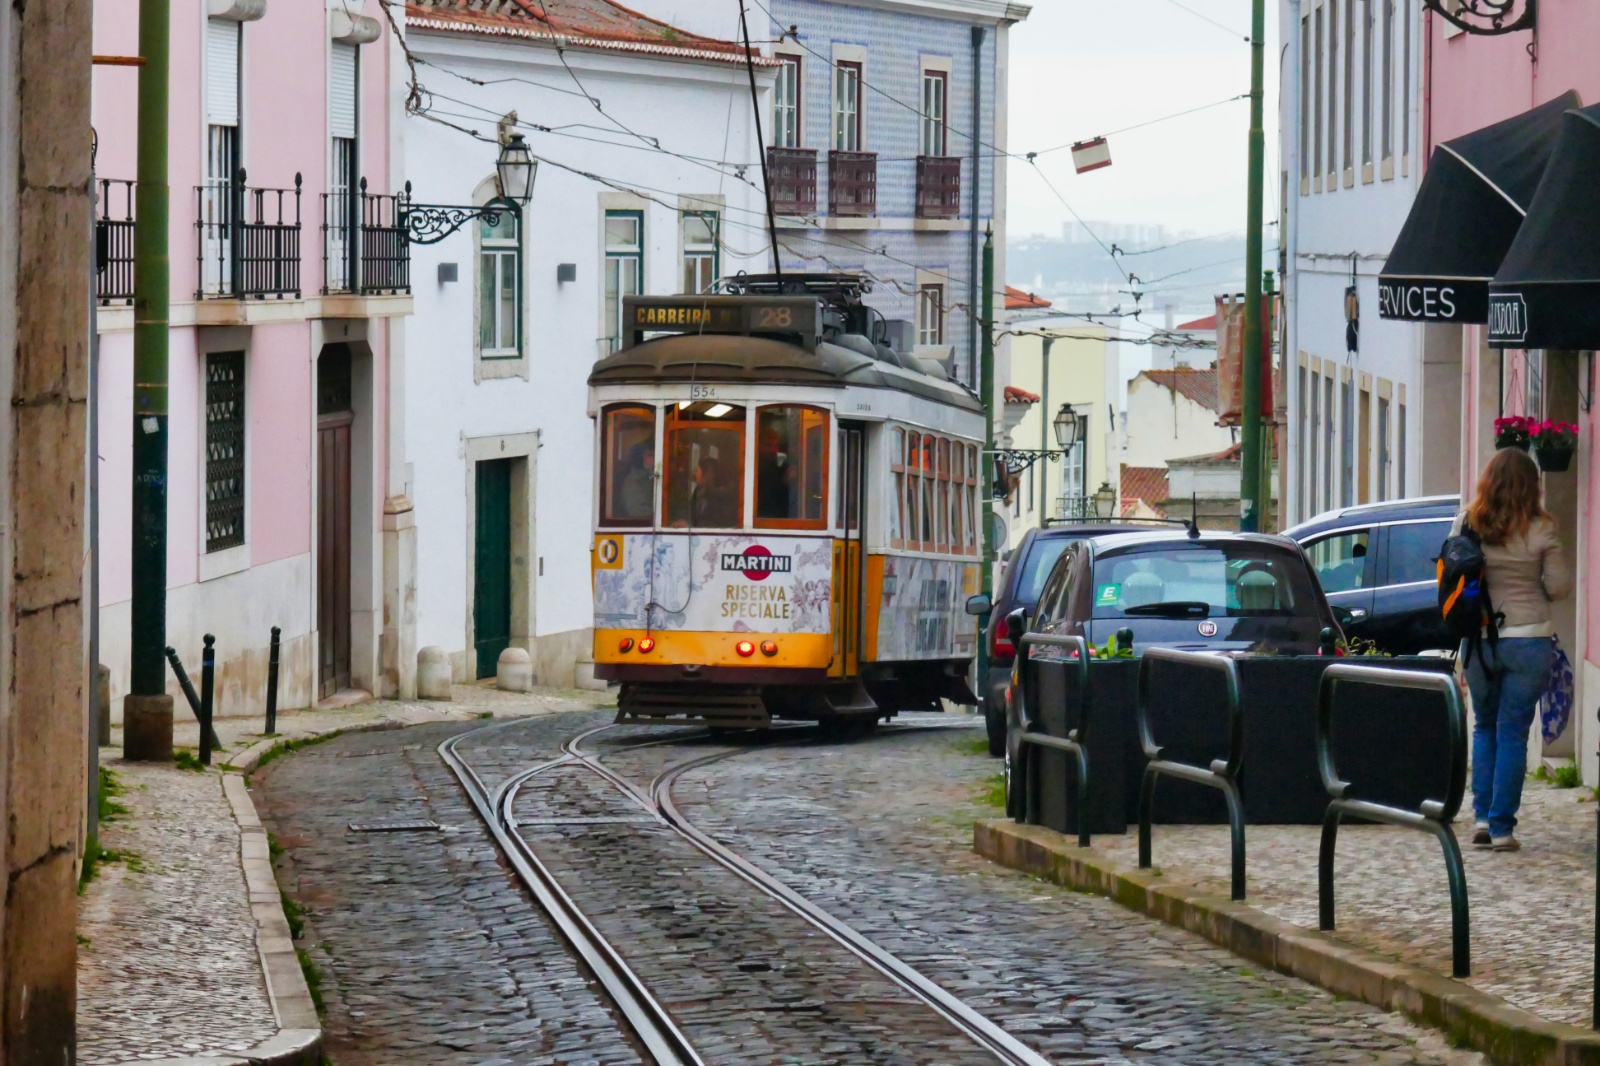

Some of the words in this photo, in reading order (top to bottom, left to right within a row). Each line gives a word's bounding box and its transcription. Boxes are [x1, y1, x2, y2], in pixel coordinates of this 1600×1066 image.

[638, 308, 711, 324] CARREIRA
[760, 307, 792, 327] 28
[693, 386, 716, 399] 554
[723, 555, 789, 571] MARTINI
[726, 584, 786, 601] RISERVA
[1102, 586, 1116, 598] E
[721, 602, 790, 619] SPECIALE
